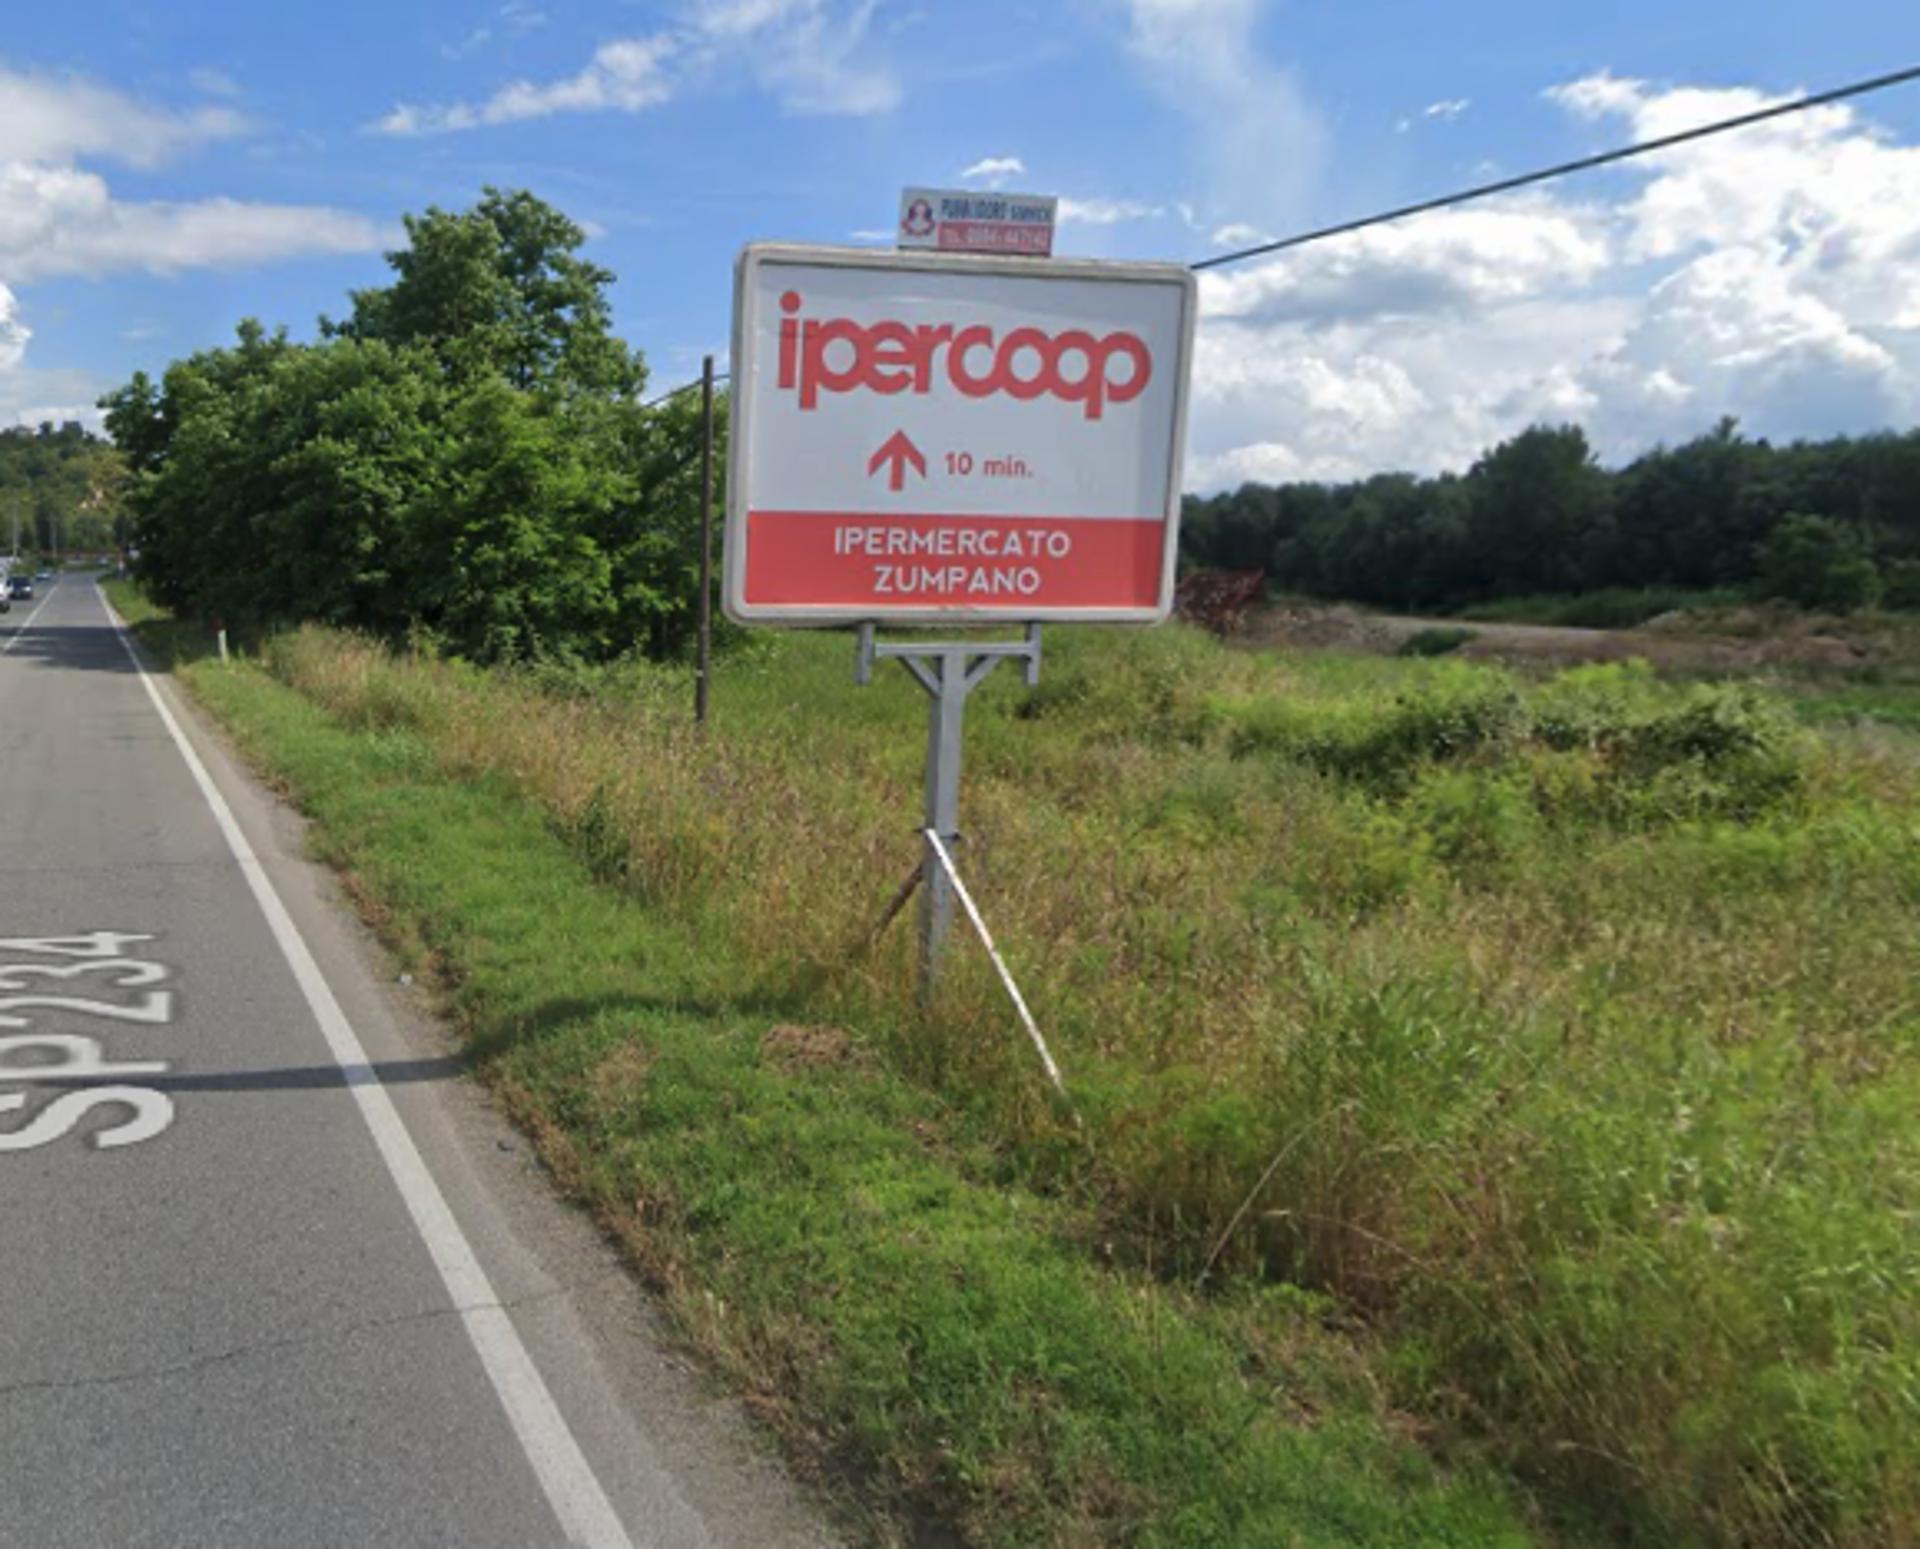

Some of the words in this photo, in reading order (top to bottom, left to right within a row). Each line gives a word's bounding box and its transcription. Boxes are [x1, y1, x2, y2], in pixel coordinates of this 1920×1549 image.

[778, 291, 1152, 420] ipercoop
[944, 453, 973, 476] 10
[984, 455, 1034, 479] min.
[834, 526, 1072, 558] IPERMERCATO
[873, 565, 1041, 595] ZUMPANO
